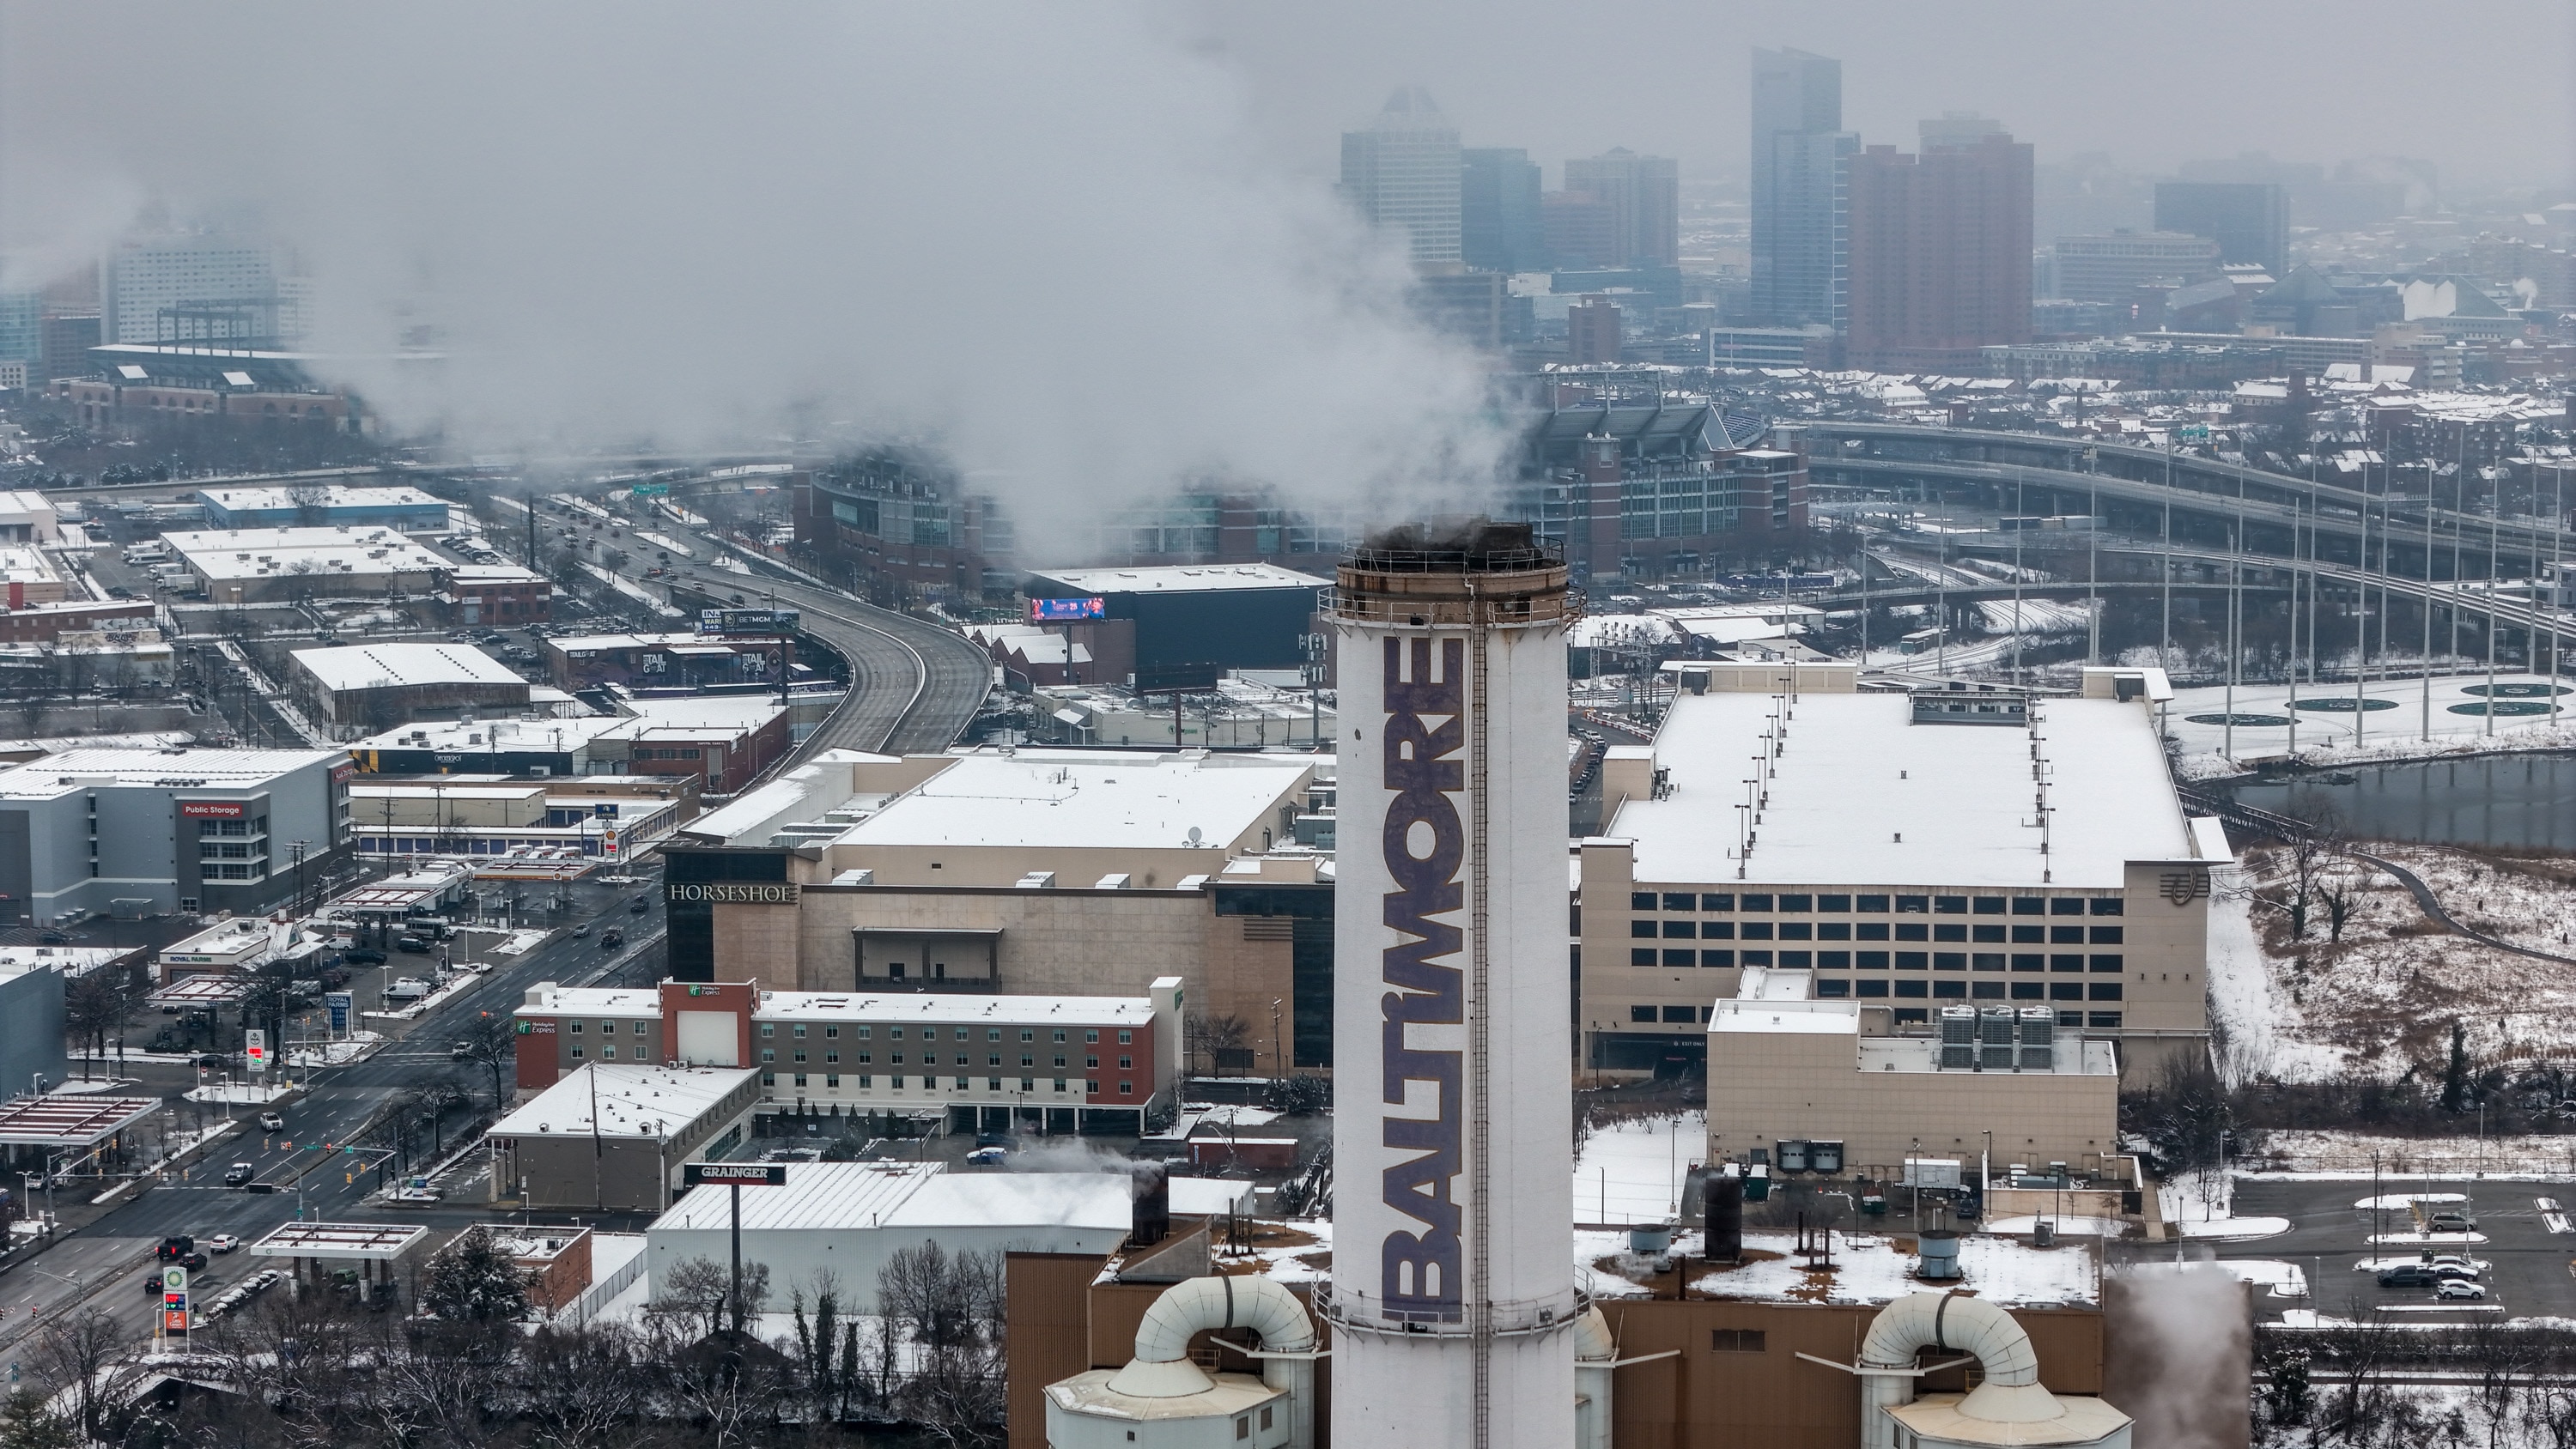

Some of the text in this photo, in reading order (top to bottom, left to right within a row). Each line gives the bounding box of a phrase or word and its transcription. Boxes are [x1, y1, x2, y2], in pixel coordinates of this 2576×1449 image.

[643, 654, 666, 665] TAIL
[742, 653, 765, 664] TAIL
[210, 806, 240, 815] Storage
[671, 884, 791, 901] HORSESHOE
[701, 1167, 769, 1179] GRAINGER
